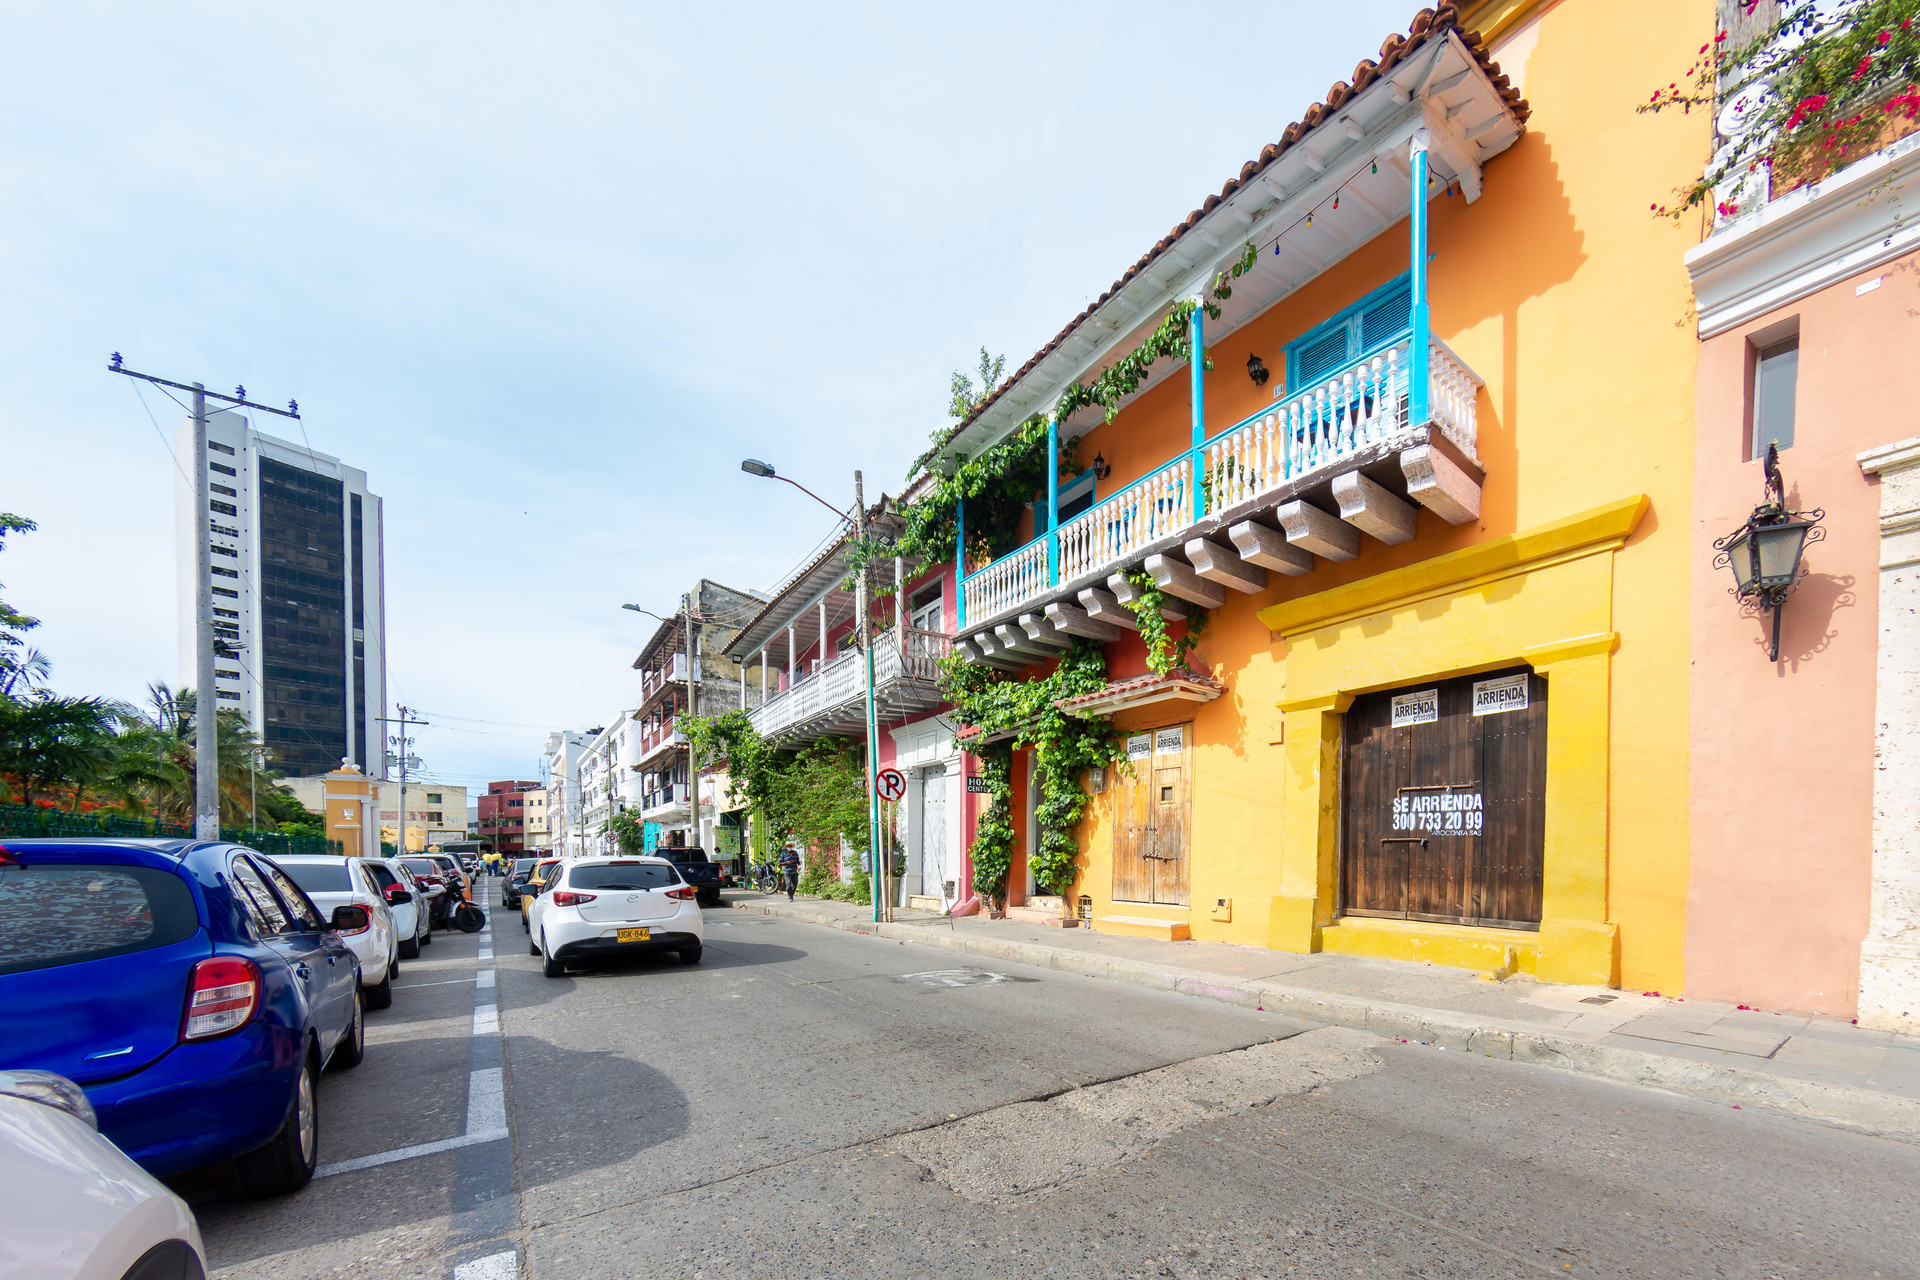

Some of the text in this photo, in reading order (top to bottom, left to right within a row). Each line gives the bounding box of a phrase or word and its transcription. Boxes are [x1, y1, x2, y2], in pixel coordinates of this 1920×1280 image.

[1477, 686, 1525, 706] ARRIENDA
[1395, 700, 1436, 718] ARRIENDA
[1129, 742, 1150, 753] ARRIENDA
[1157, 736, 1181, 748] ARRIENDA
[1392, 794, 1483, 813] SE ARRIENDA
[1392, 811, 1483, 831] 300 733 20 99
